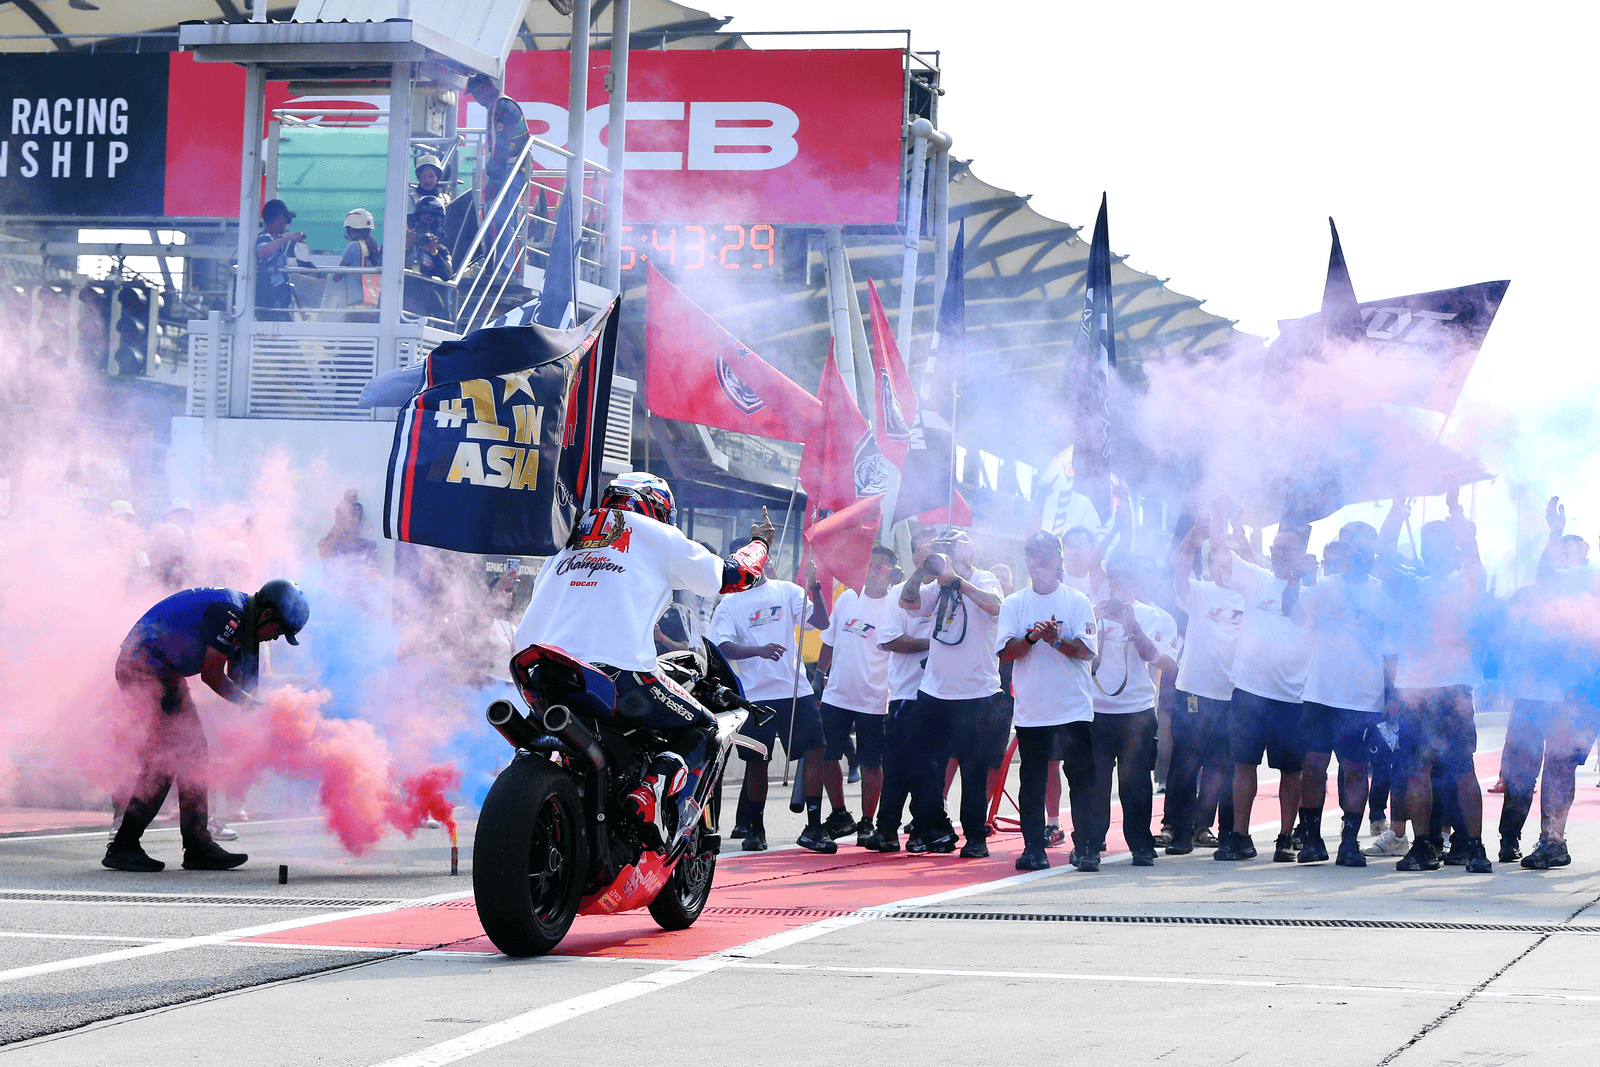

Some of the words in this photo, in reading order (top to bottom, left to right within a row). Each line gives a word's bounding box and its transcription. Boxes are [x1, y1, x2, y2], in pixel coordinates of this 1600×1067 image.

[11, 97, 128, 135] RACING
[466, 101, 800, 171] RCB
[434, 378, 510, 442] #1
[512, 404, 545, 446] IN
[446, 441, 540, 491] ASIA
[485, 562, 504, 573] SEPANG
[557, 554, 627, 578] Champion
[576, 551, 608, 563] Team
